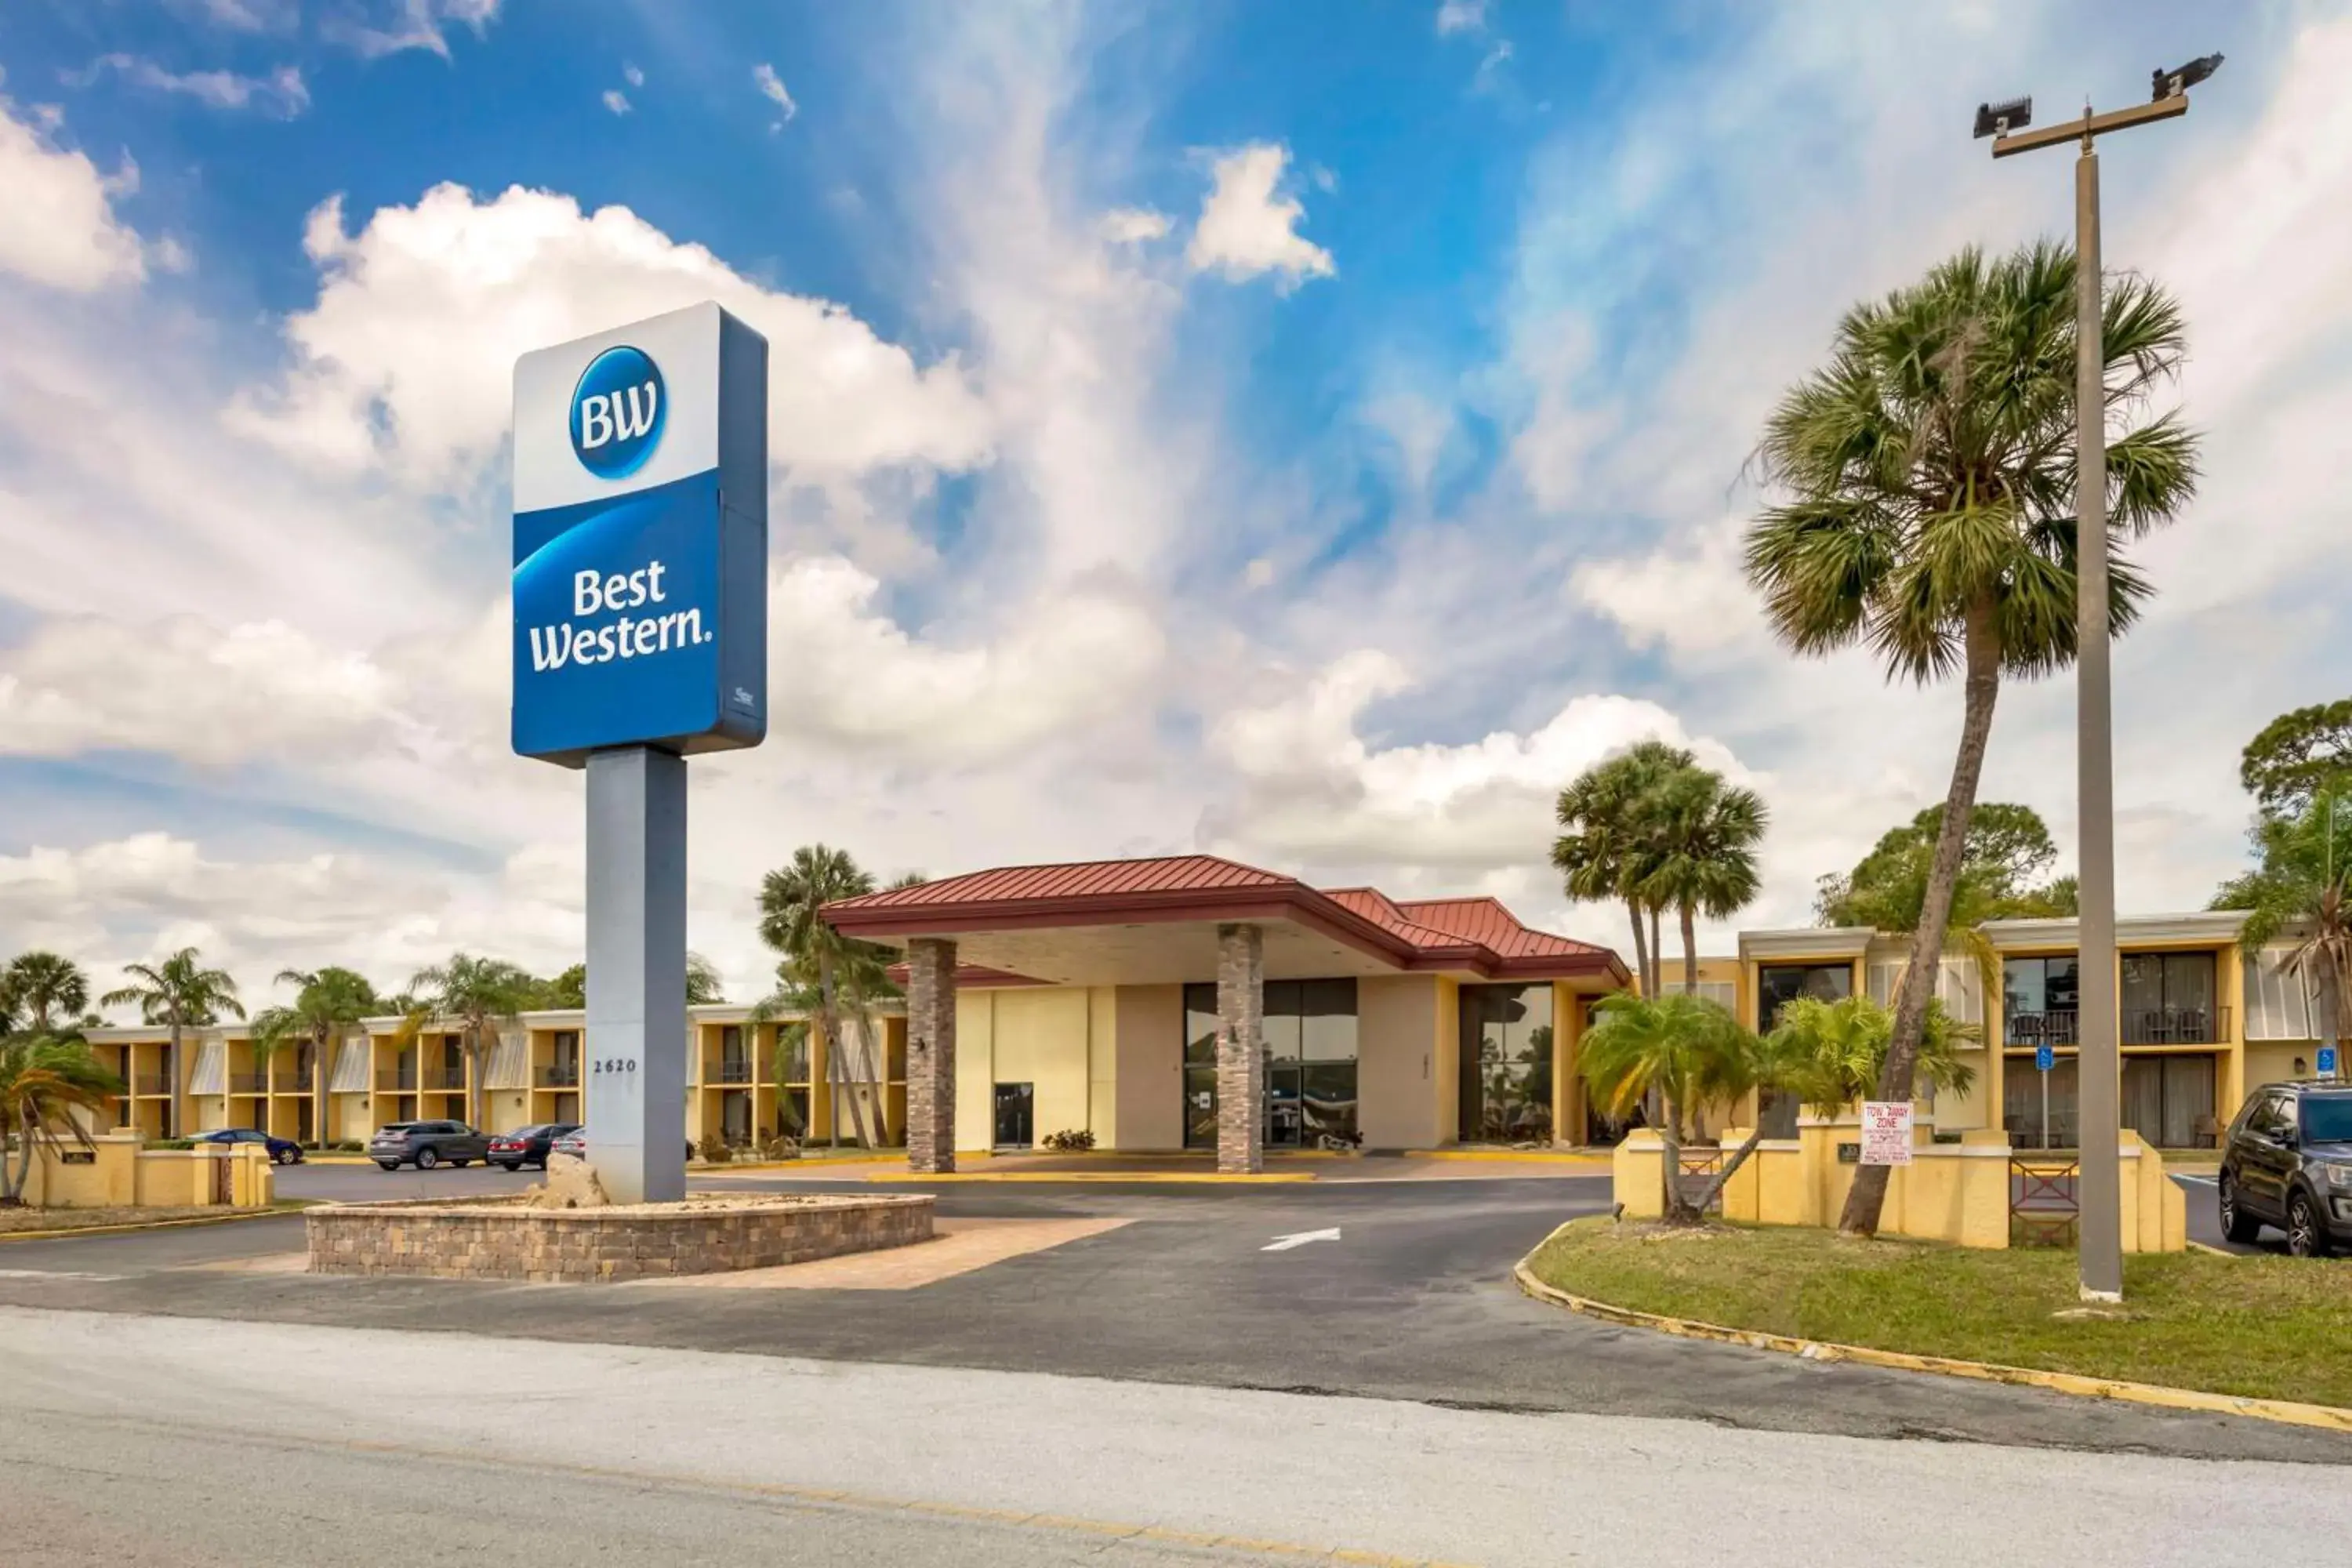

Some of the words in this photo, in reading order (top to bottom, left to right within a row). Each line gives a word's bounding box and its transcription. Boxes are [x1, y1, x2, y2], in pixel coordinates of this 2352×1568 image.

[582, 381, 656, 449] BW
[575, 561, 666, 616] Best
[593, 1058, 636, 1073] 2620
[1876, 1117, 1897, 1128] ZONE
